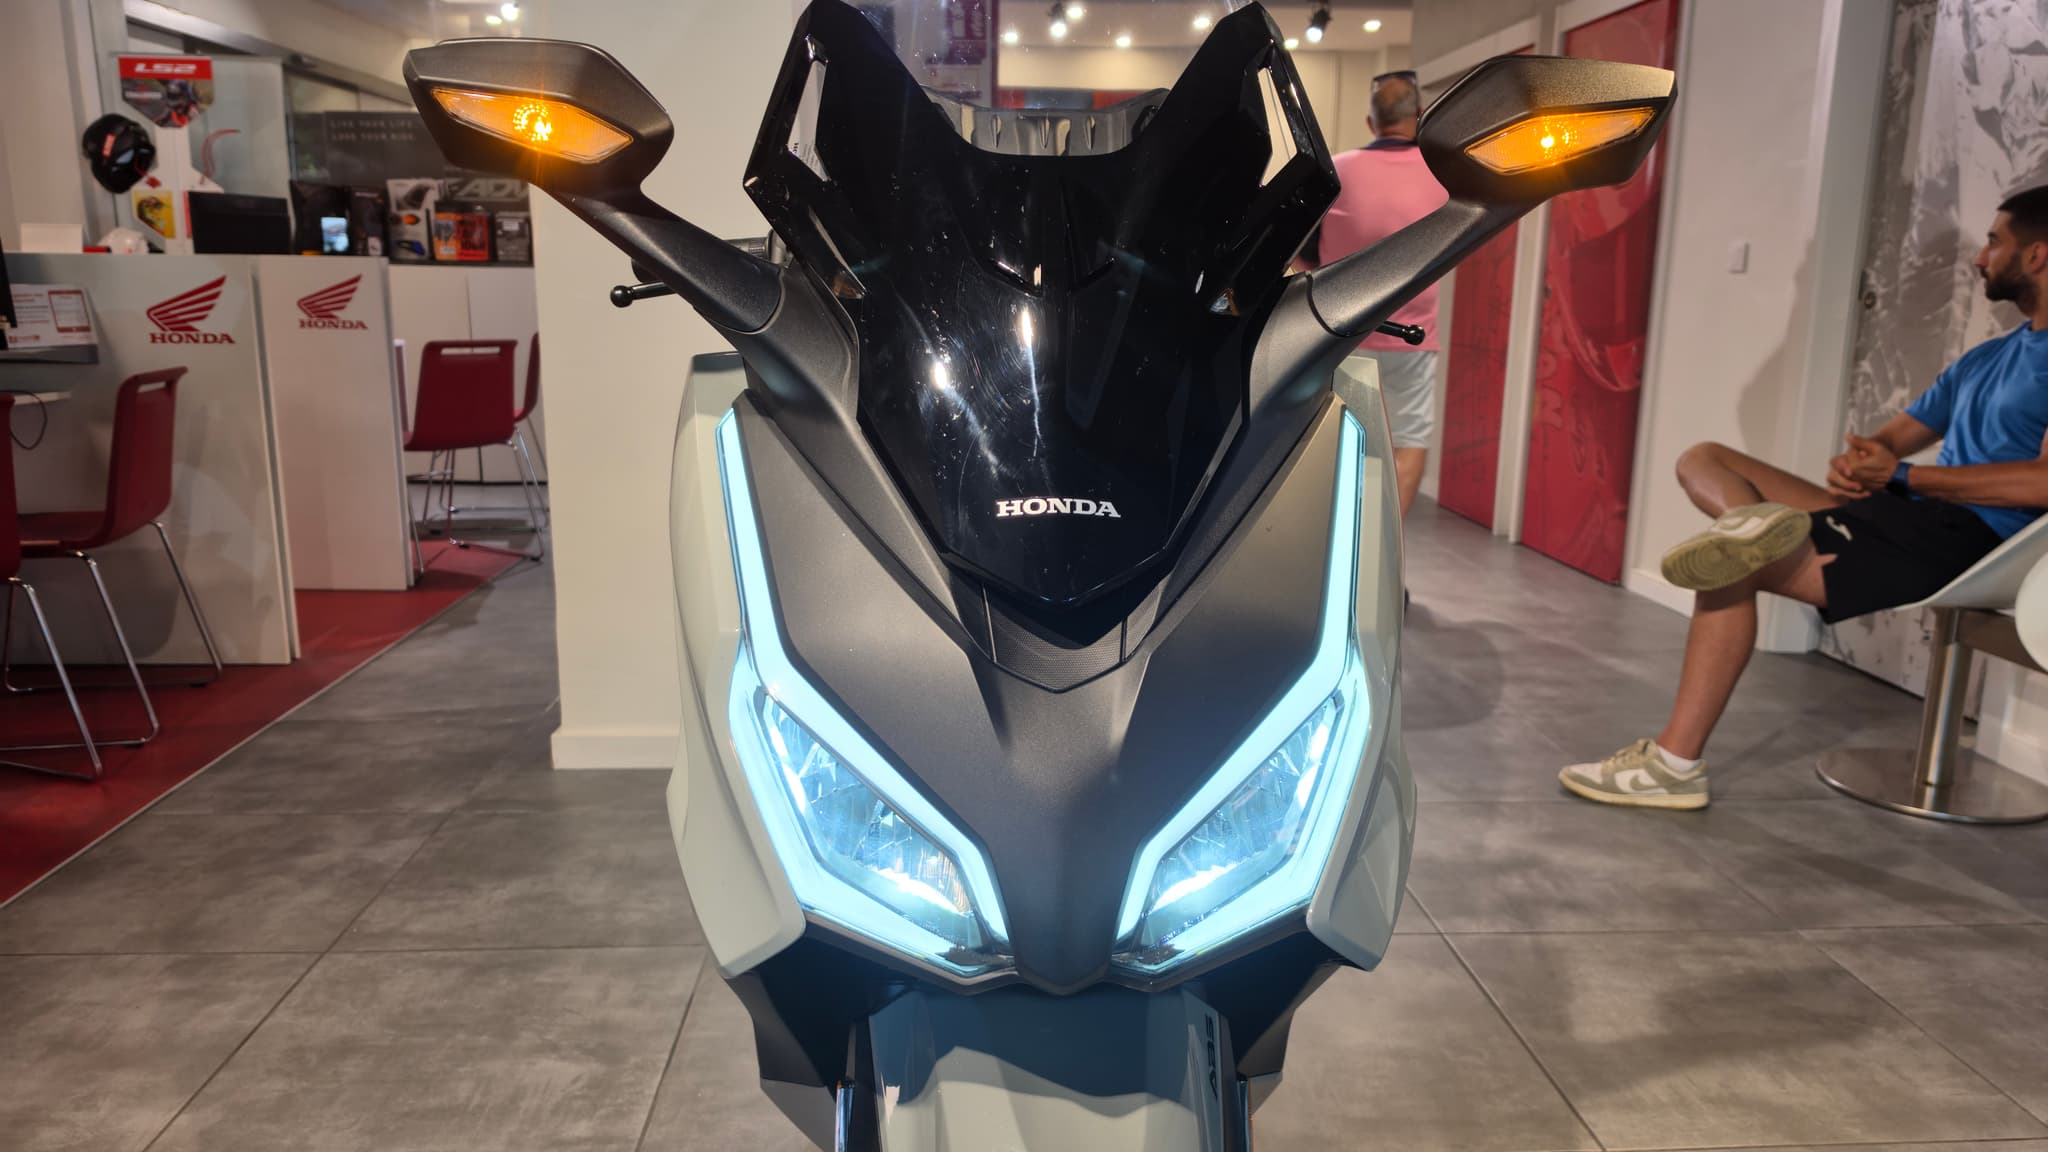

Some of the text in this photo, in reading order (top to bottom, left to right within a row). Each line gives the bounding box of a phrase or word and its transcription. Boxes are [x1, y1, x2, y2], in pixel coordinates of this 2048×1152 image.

[134, 63, 197, 74] LS2
[299, 319, 368, 329] HONDA
[150, 333, 235, 344] HONDA
[996, 498, 1121, 518] HONDA
